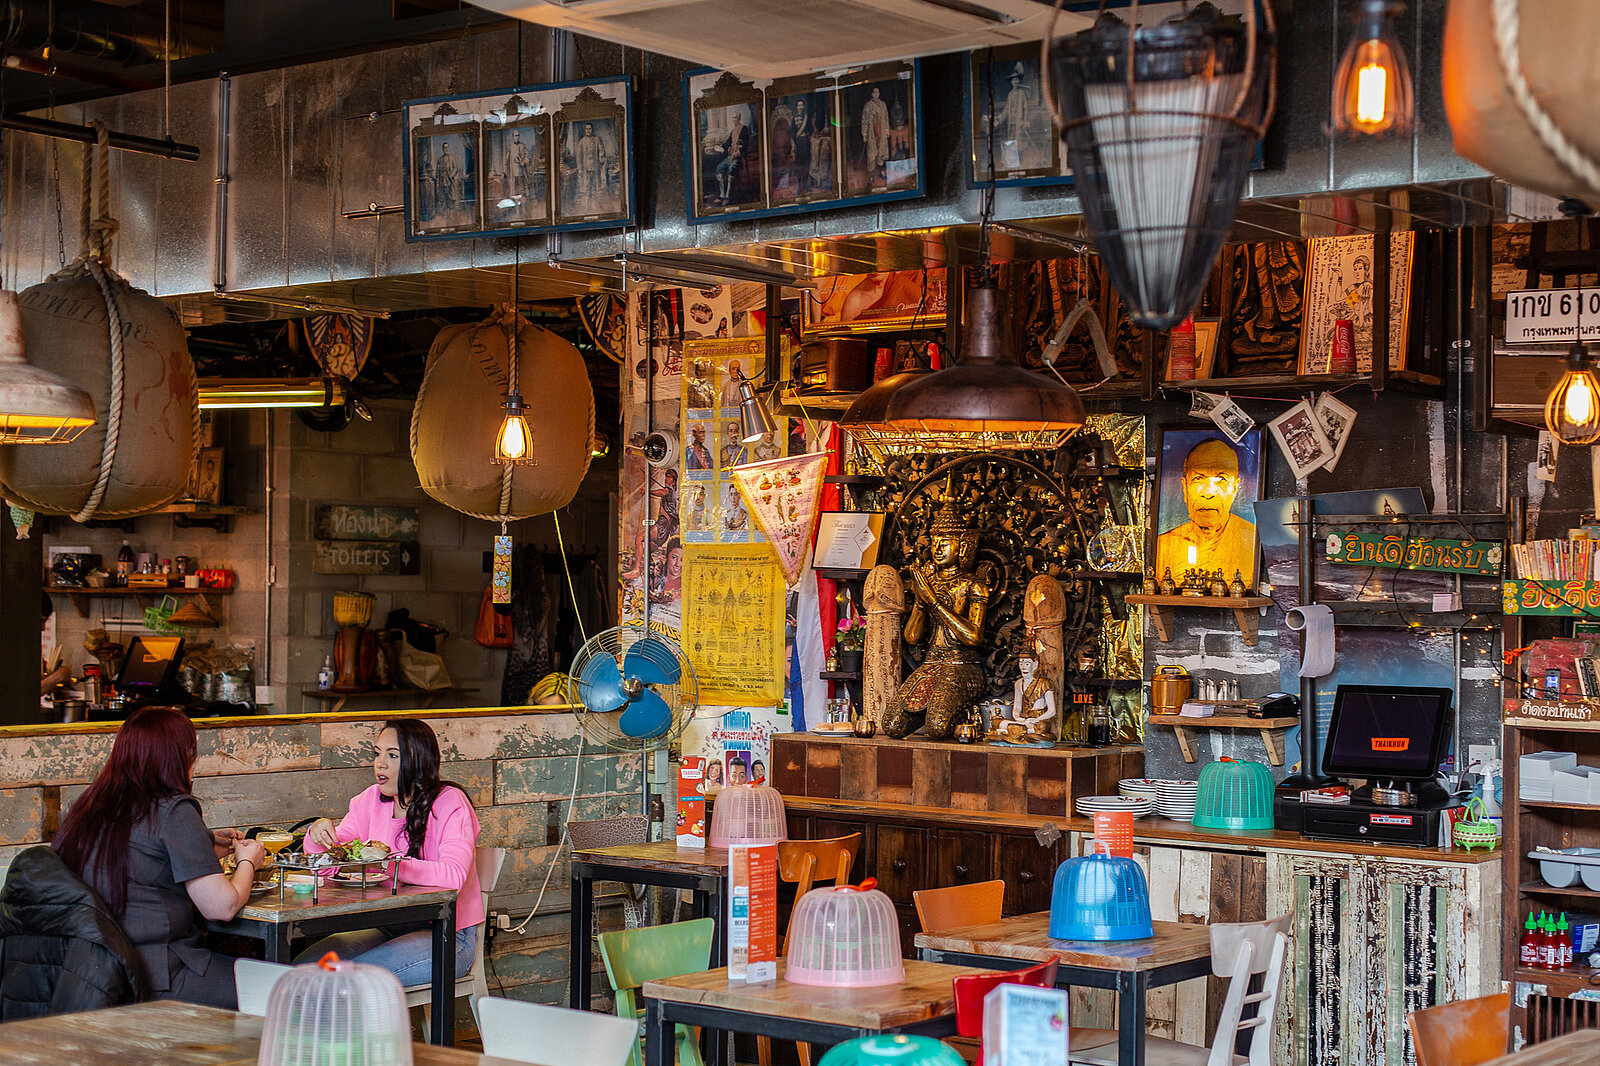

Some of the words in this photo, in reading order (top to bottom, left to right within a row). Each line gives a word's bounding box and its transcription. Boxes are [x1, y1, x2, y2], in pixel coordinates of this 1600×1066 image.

[331, 506, 389, 534] ห้องน้ำ
[330, 549, 390, 565] TOILETS
[1344, 534, 1484, 569] ยินดีต้อนรับ
[1374, 740, 1406, 748] THAIKHUN
